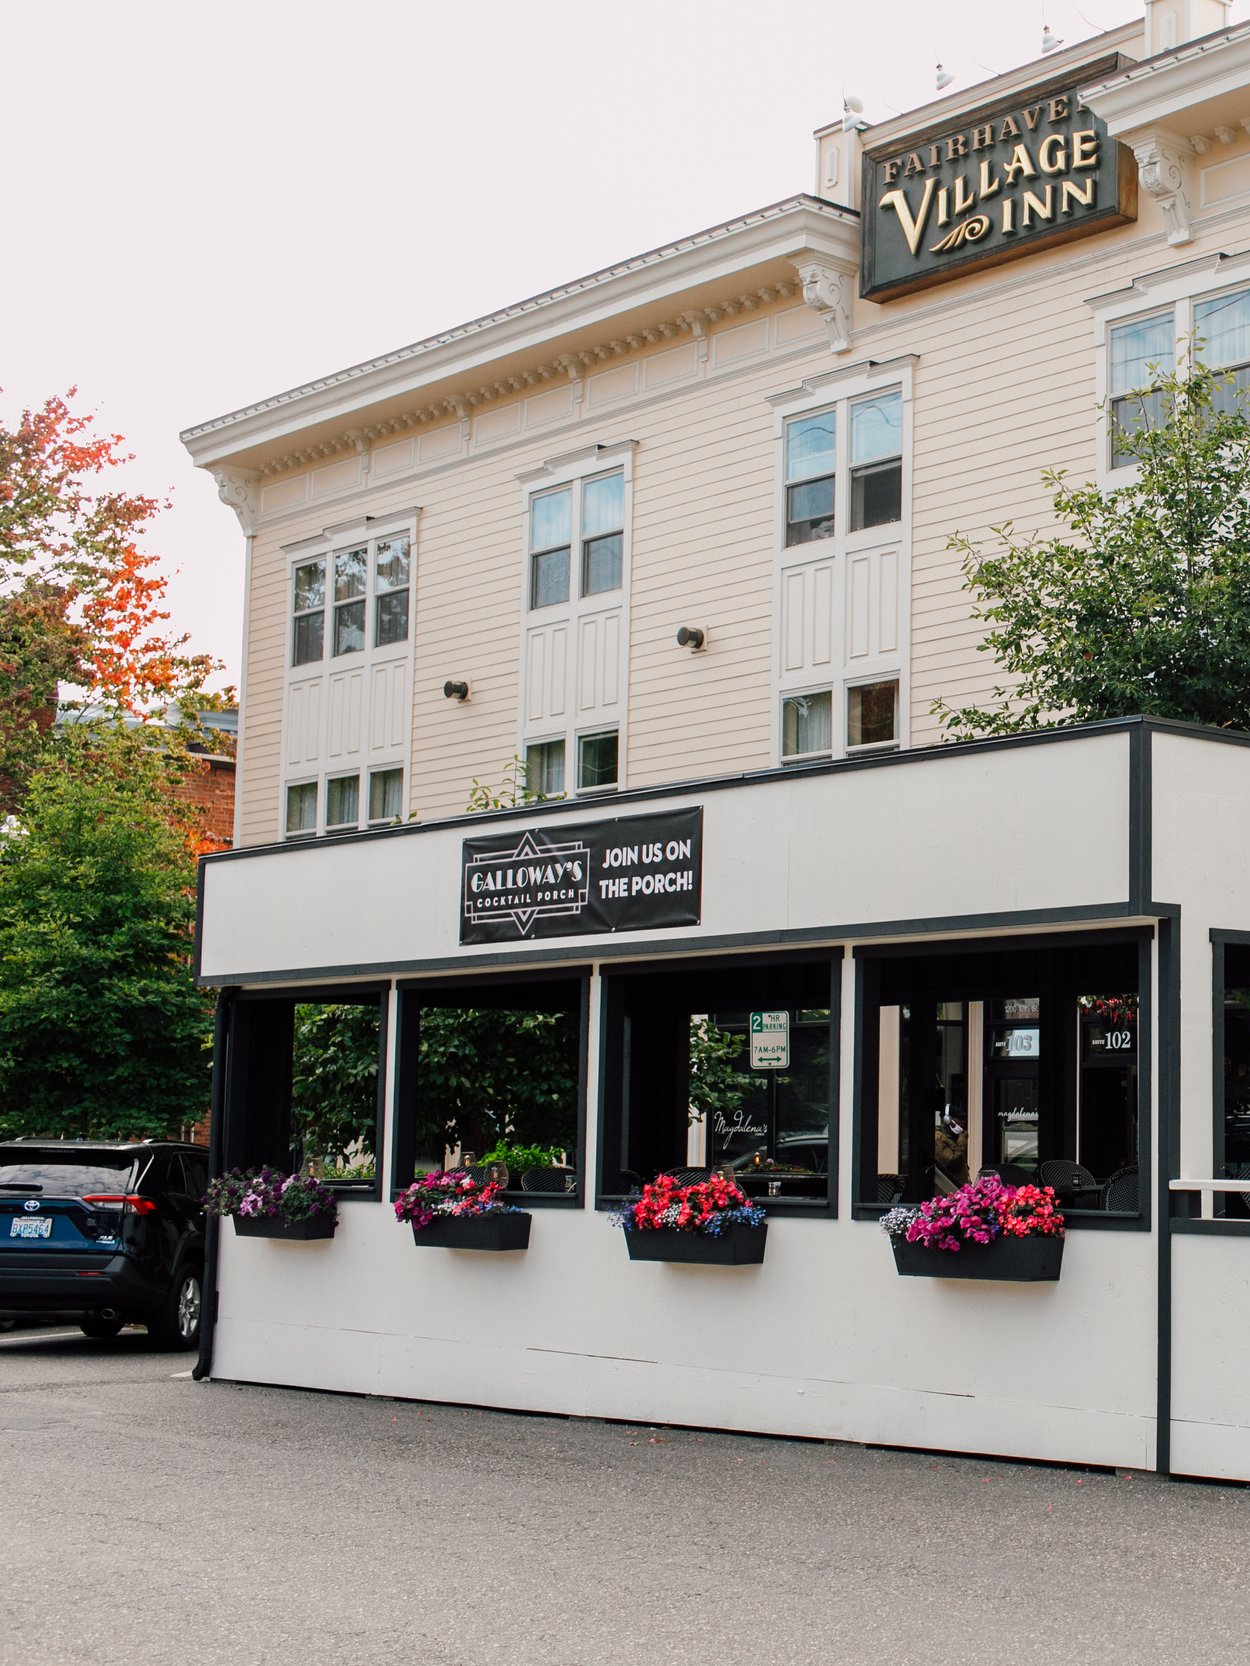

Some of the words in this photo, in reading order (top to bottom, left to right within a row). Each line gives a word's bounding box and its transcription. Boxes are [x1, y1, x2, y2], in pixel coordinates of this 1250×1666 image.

[883, 95, 1088, 185] FAIRHAVE
[879, 129, 1098, 256] VILLAGE
[1001, 178, 1096, 235] INN
[602, 845, 639, 869] JOIN
[642, 843, 662, 863] US
[666, 839, 691, 860] ON
[470, 860, 583, 893] GALLOWAY'S
[599, 878, 629, 899] THE
[631, 871, 693, 896] PORCH!
[477, 892, 531, 908] COCKTAIL
[537, 889, 574, 902] PORCH
[752, 1015, 761, 1030] 2
[763, 1023, 786, 1031] PARKING
[754, 1045, 786, 1053] 7AM-6PM
[1006, 1034, 1032, 1051] 103
[1105, 1030, 1131, 1049] 102
